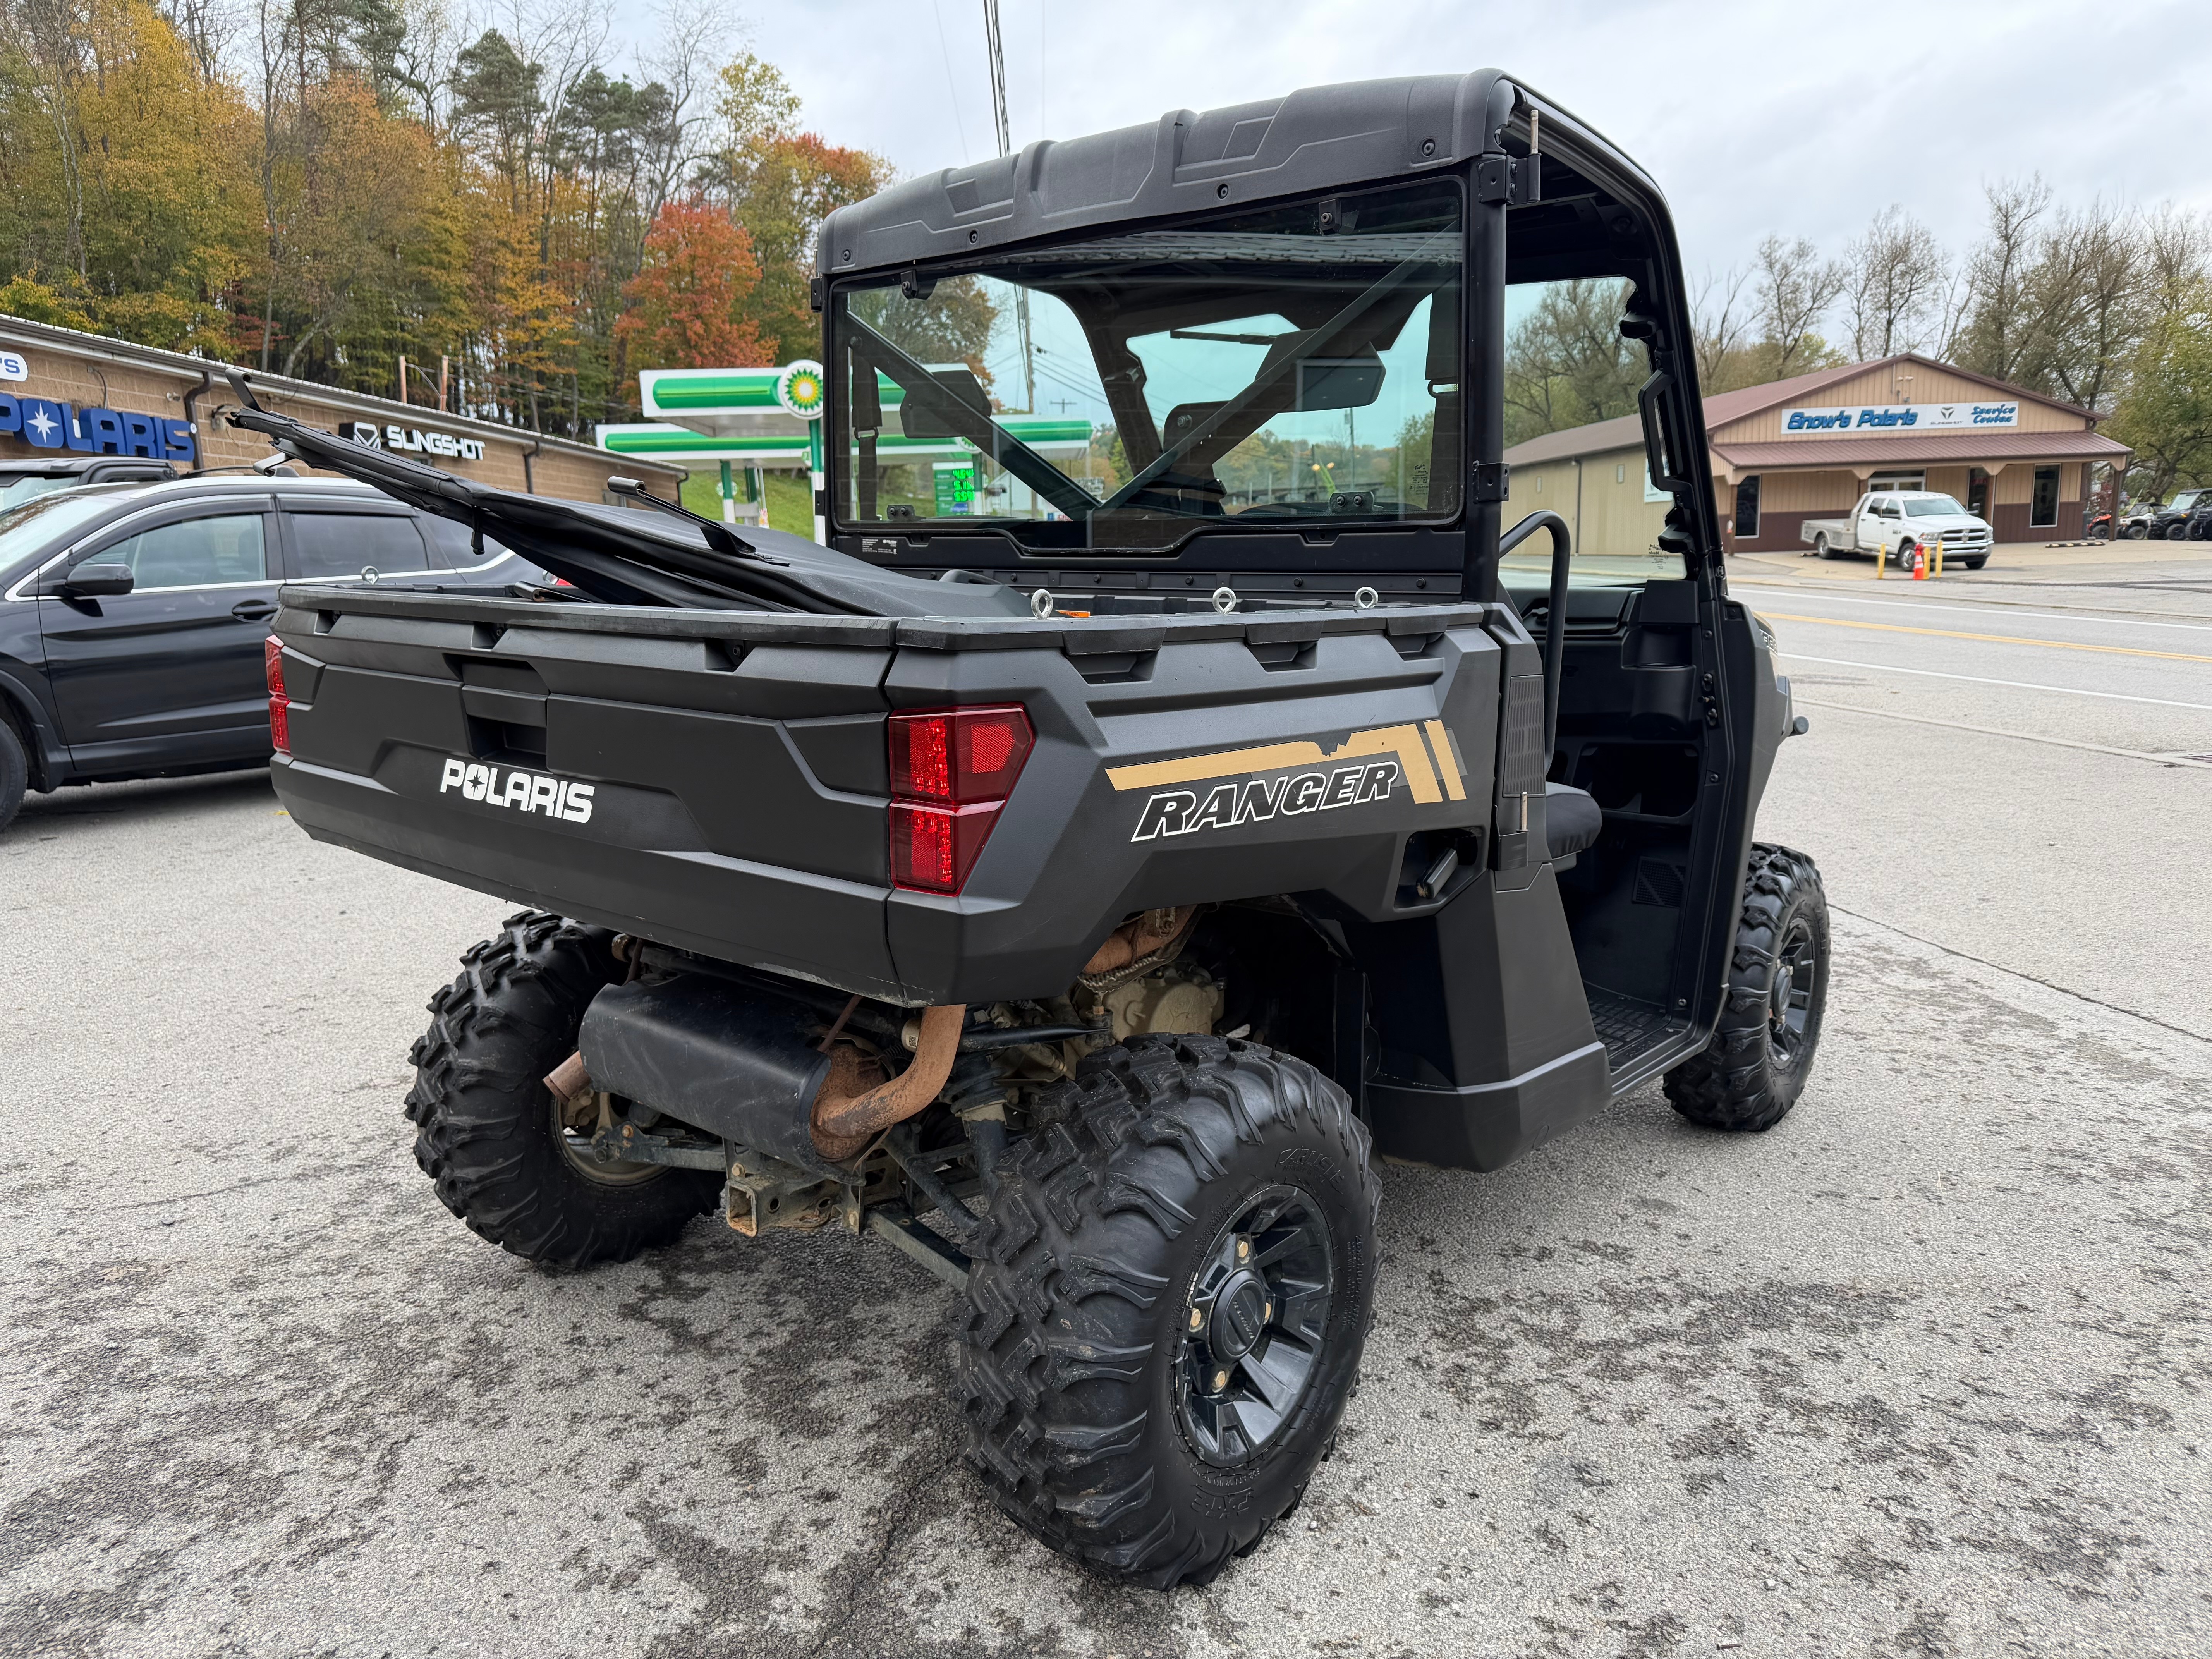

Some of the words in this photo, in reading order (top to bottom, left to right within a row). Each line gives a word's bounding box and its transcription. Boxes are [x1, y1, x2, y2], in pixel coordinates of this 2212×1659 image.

[1787, 410, 1852, 429] Snow's
[1856, 408, 1918, 428] Polaris
[1971, 404, 2016, 415] Service
[1973, 415, 2013, 424] Center
[386, 424, 486, 461] SLINGSHOT
[440, 758, 595, 823] POLARIS
[1130, 761, 1398, 843] RANGER
